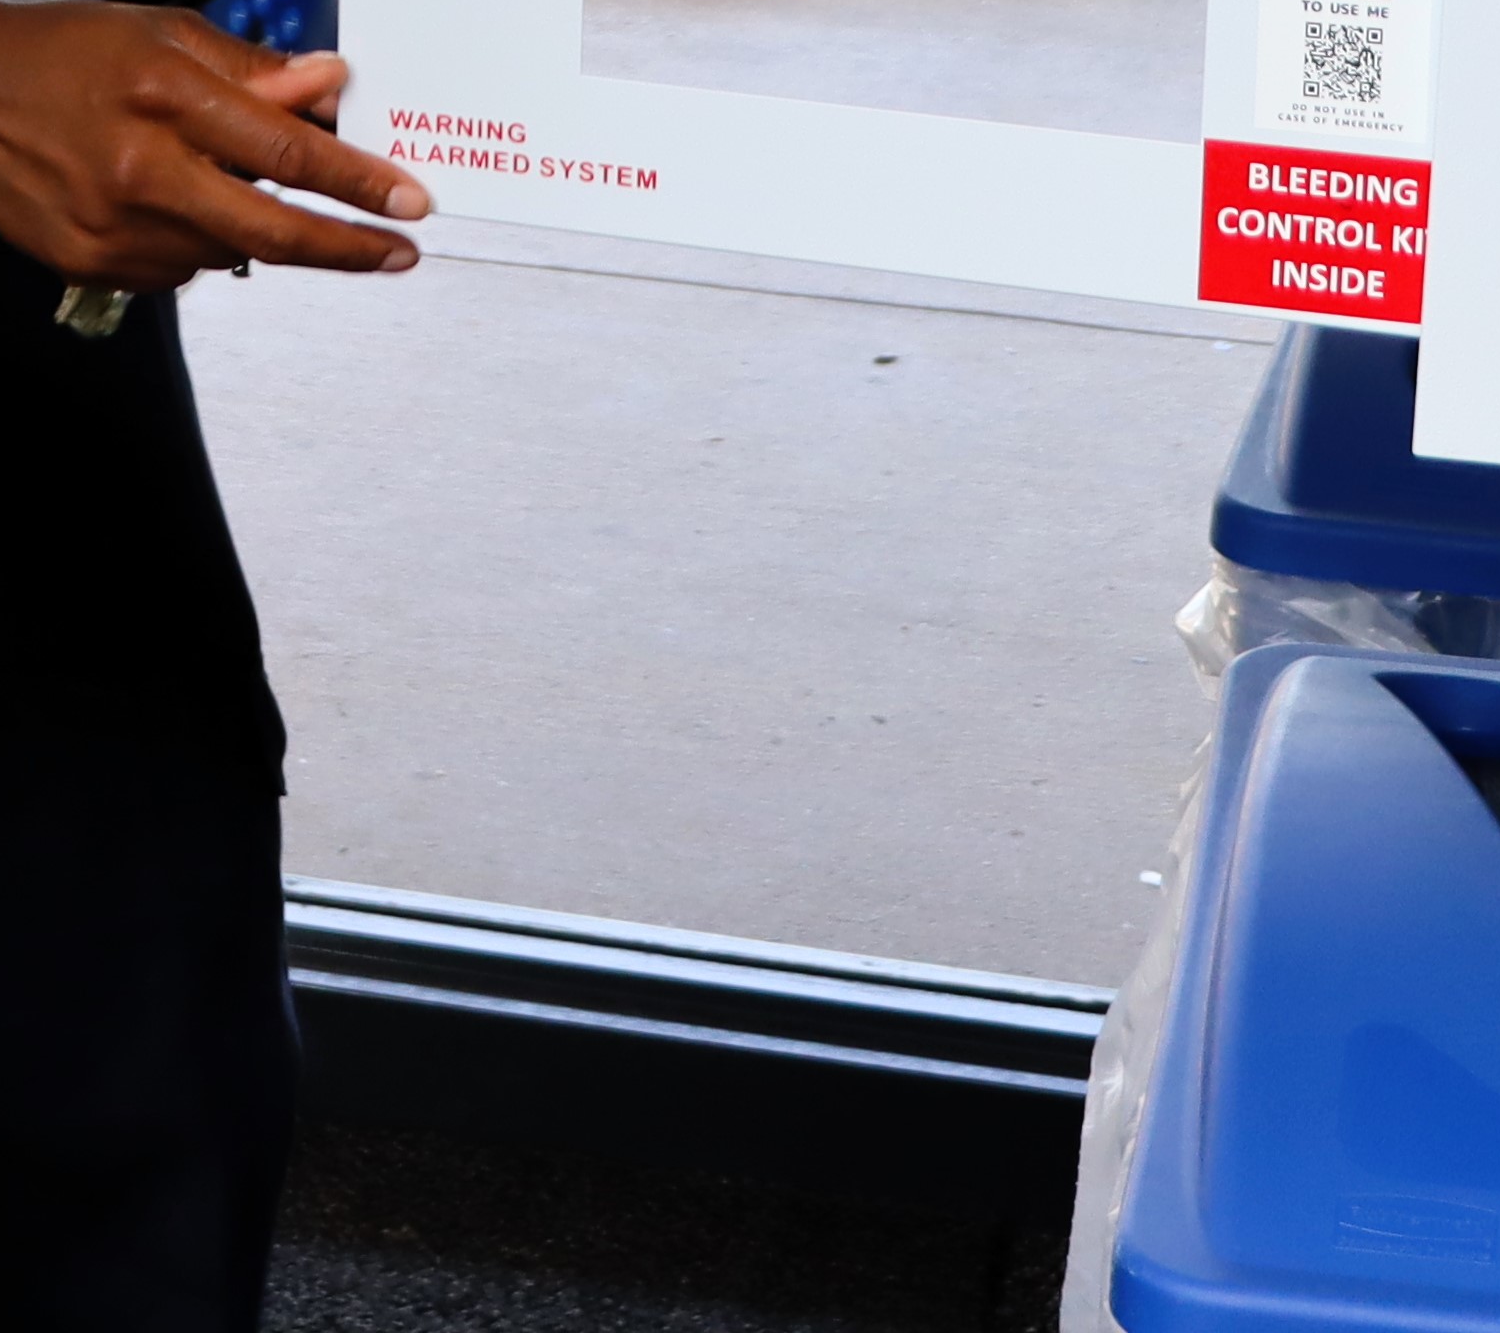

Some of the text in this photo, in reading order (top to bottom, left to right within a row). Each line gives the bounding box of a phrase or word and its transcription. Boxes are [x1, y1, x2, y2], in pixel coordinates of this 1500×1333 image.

[1302, 0, 1389, 18] TO USE ME
[389, 108, 527, 144] WARNING
[1278, 113, 1404, 132] CASE OF EMERGENCY
[1292, 103, 1385, 119] DO NOT USE IN
[389, 140, 658, 190] ALARMED SYSTEM
[1248, 162, 1419, 207] BLEEDING
[1217, 207, 1428, 255] CONTROL KI
[1271, 259, 1386, 299] INSIDE
